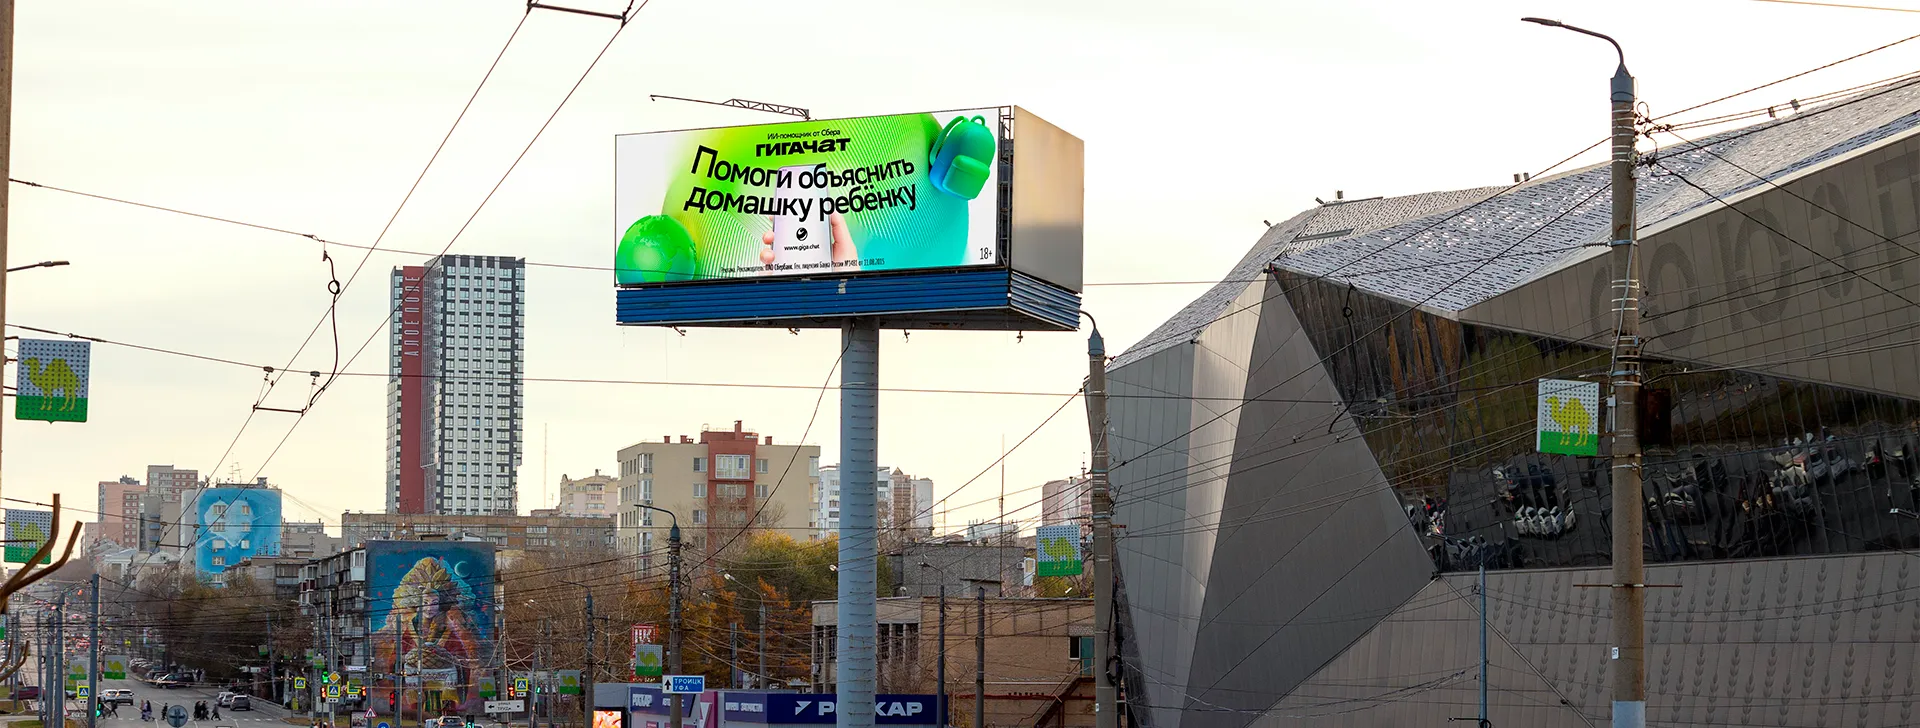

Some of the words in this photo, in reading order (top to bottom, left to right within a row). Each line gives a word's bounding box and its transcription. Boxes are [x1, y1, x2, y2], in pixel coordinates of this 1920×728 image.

[821, 128, 840, 137] Сбера
[691, 145, 793, 189] Помоги
[799, 158, 915, 189] объяснить
[683, 185, 813, 222] домашку
[819, 183, 916, 222] ребёнку
[980, 247, 992, 260] 18+
[404, 276, 420, 313] ПОЛЕ
[404, 320, 420, 357] АЛОЕ
[674, 677, 702, 685] ТРОИЦК
[818, 701, 923, 717] РКАР
